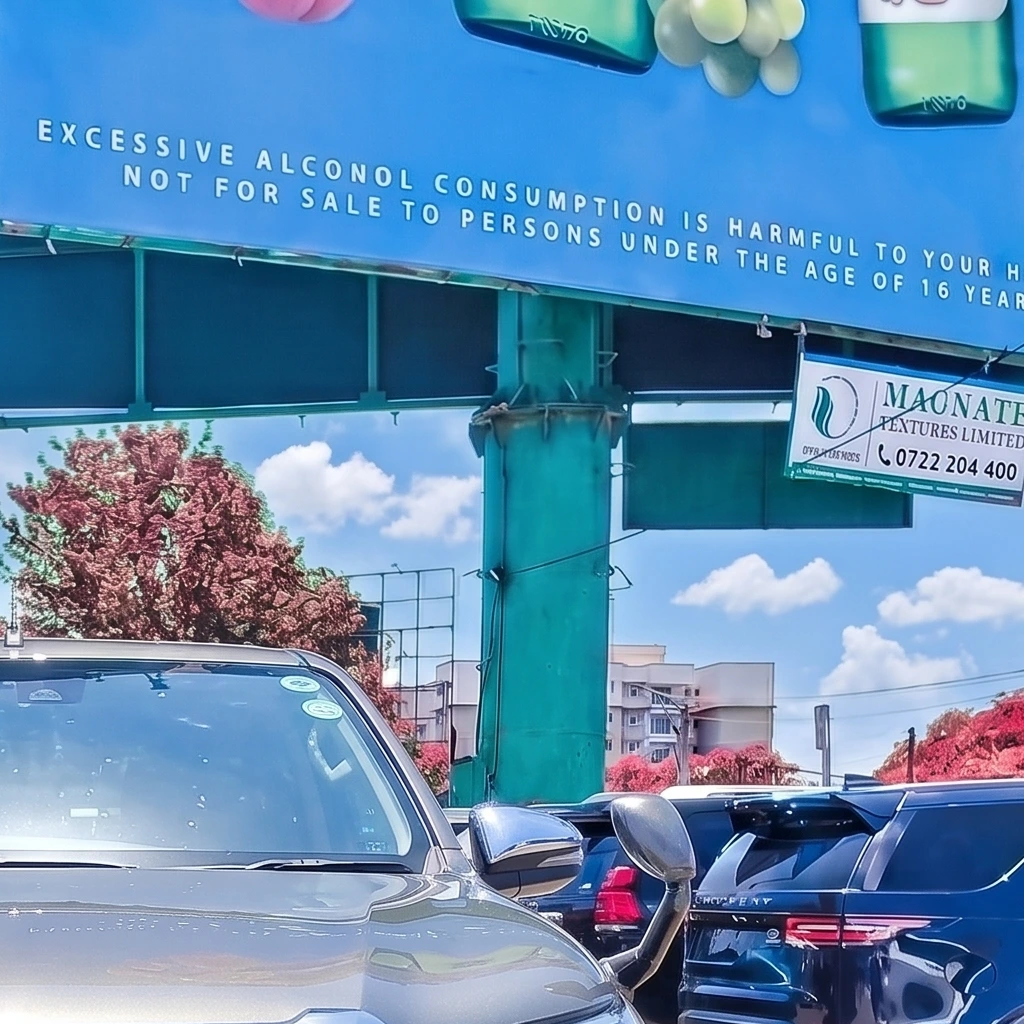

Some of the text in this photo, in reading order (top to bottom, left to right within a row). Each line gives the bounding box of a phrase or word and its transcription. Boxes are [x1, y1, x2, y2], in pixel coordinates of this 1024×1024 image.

[38, 119, 234, 165] EXCESSIVE
[435, 174, 665, 226] CONSUMPTION
[683, 211, 709, 233] IS
[729, 217, 860, 257] HARMFUL
[876, 242, 907, 264] TO
[923, 249, 990, 277] YOUR
[124, 164, 1024, 310] NOT FOR SALE TO PERSONS UNDER THE AGE OF 16 YEAR
[880, 415, 1024, 450] TEXTURES LIMITED
[896, 448, 1017, 481] 0722 204 400
